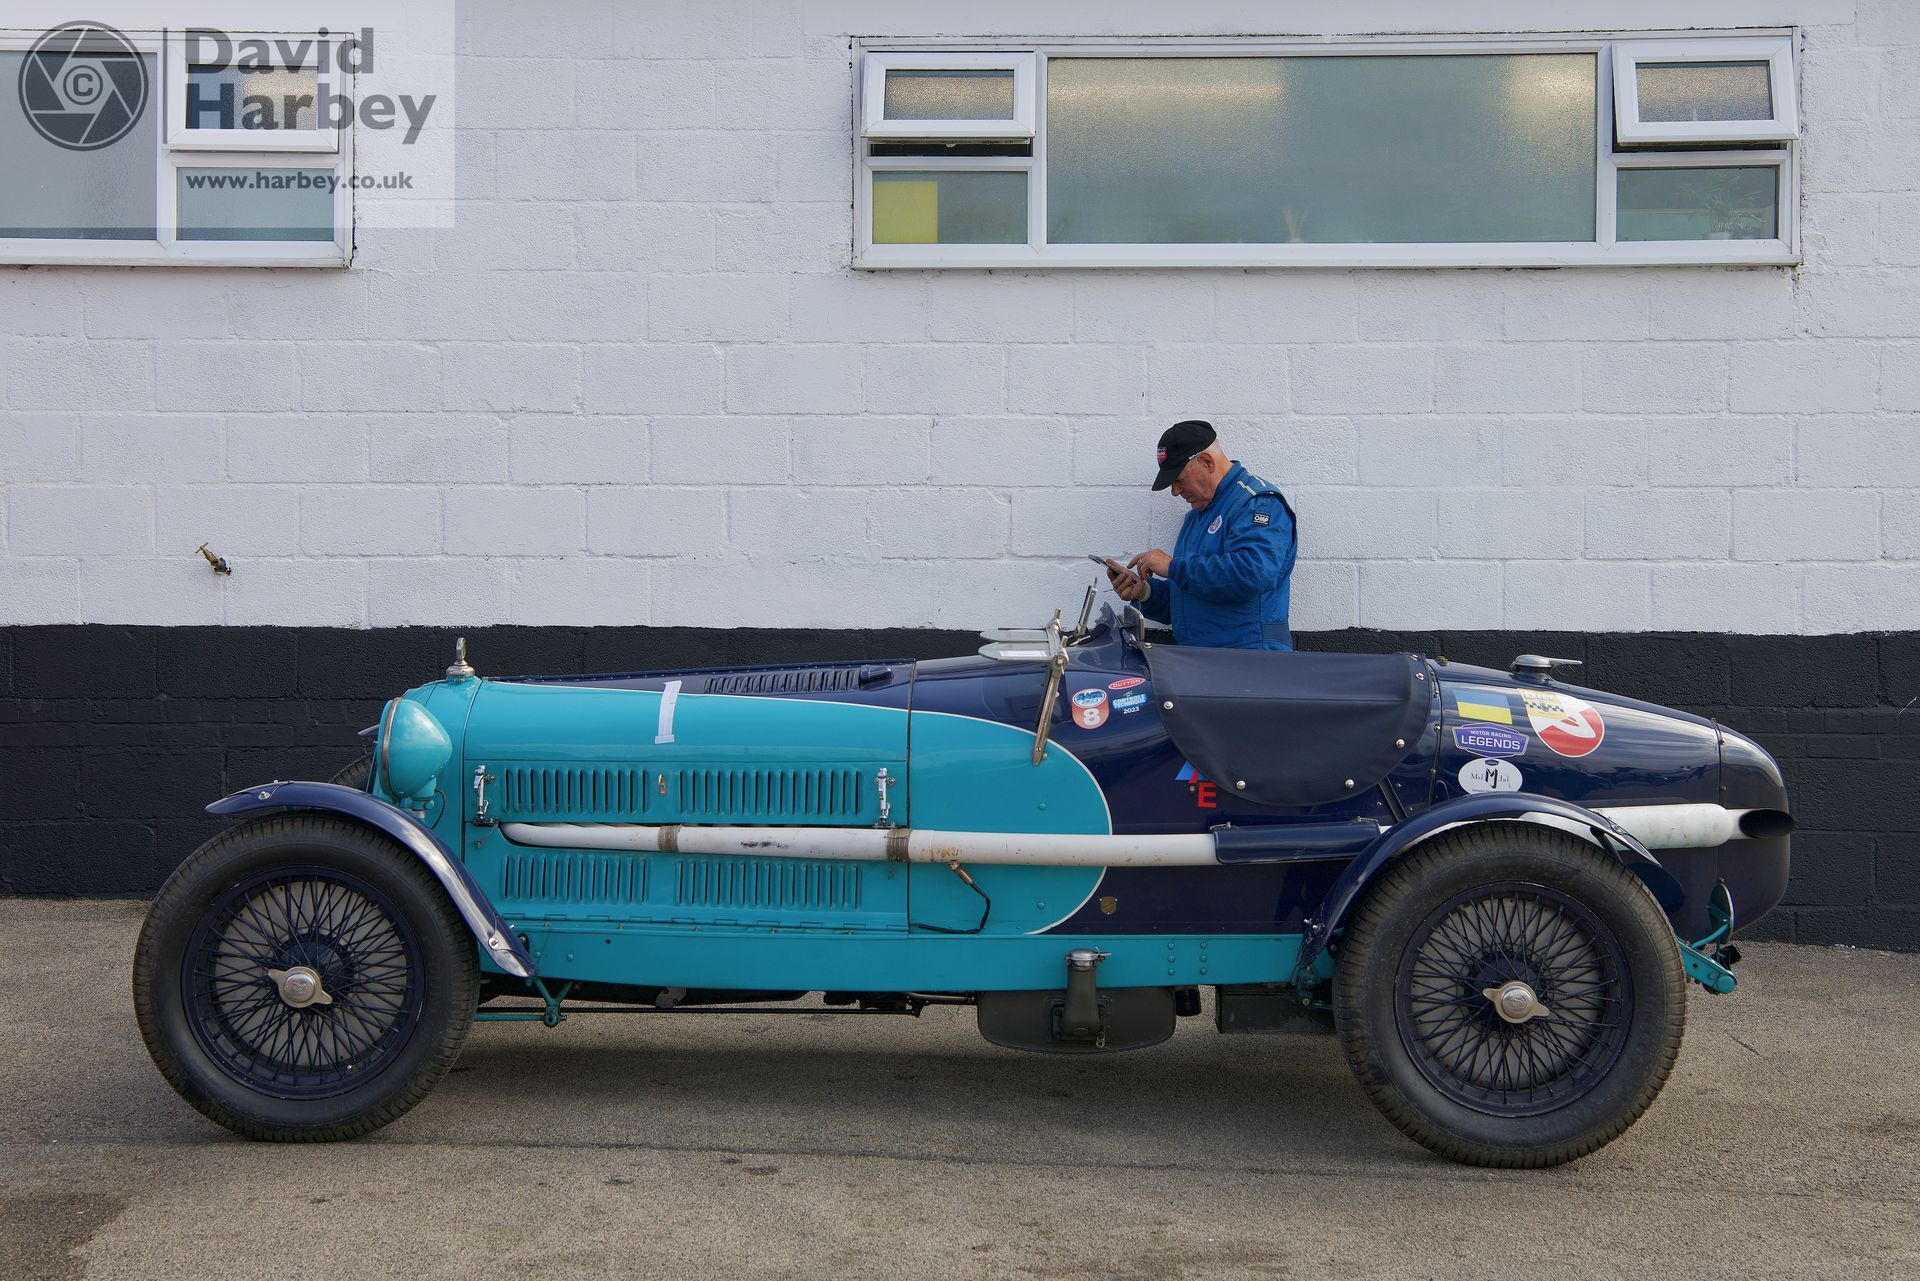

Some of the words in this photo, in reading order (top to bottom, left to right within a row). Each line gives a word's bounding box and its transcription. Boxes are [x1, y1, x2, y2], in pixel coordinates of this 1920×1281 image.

[1123, 706, 1140, 714] 2023
[1083, 708, 1101, 726] 8
[1491, 731, 1512, 739] RACING
[1461, 735, 1520, 750] LEGENDS
